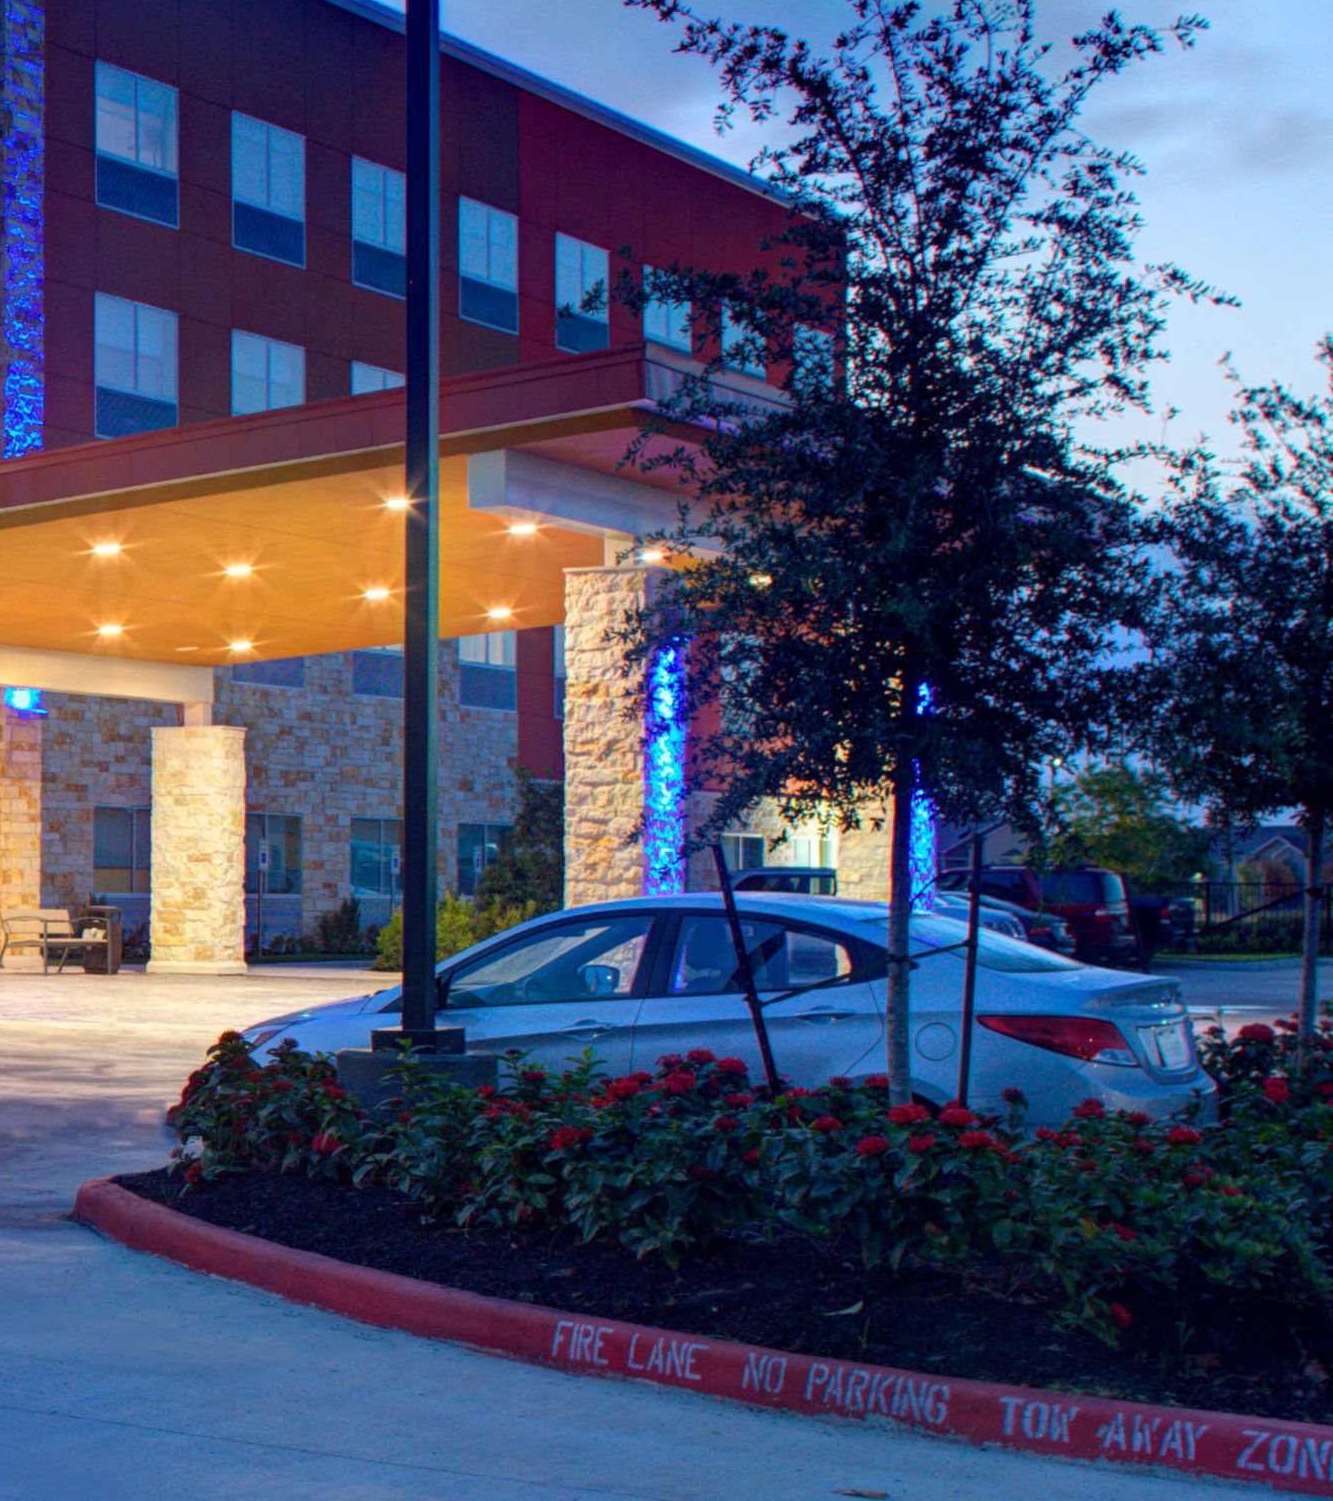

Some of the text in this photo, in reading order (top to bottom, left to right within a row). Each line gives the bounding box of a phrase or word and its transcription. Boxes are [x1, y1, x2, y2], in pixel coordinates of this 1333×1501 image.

[551, 1319, 614, 1366] FIRE
[627, 1331, 709, 1381] LANE
[742, 1351, 787, 1394] NO
[804, 1362, 950, 1425] PARKING
[999, 1396, 1080, 1443] TOW
[1236, 1429, 1333, 1482] ZON
